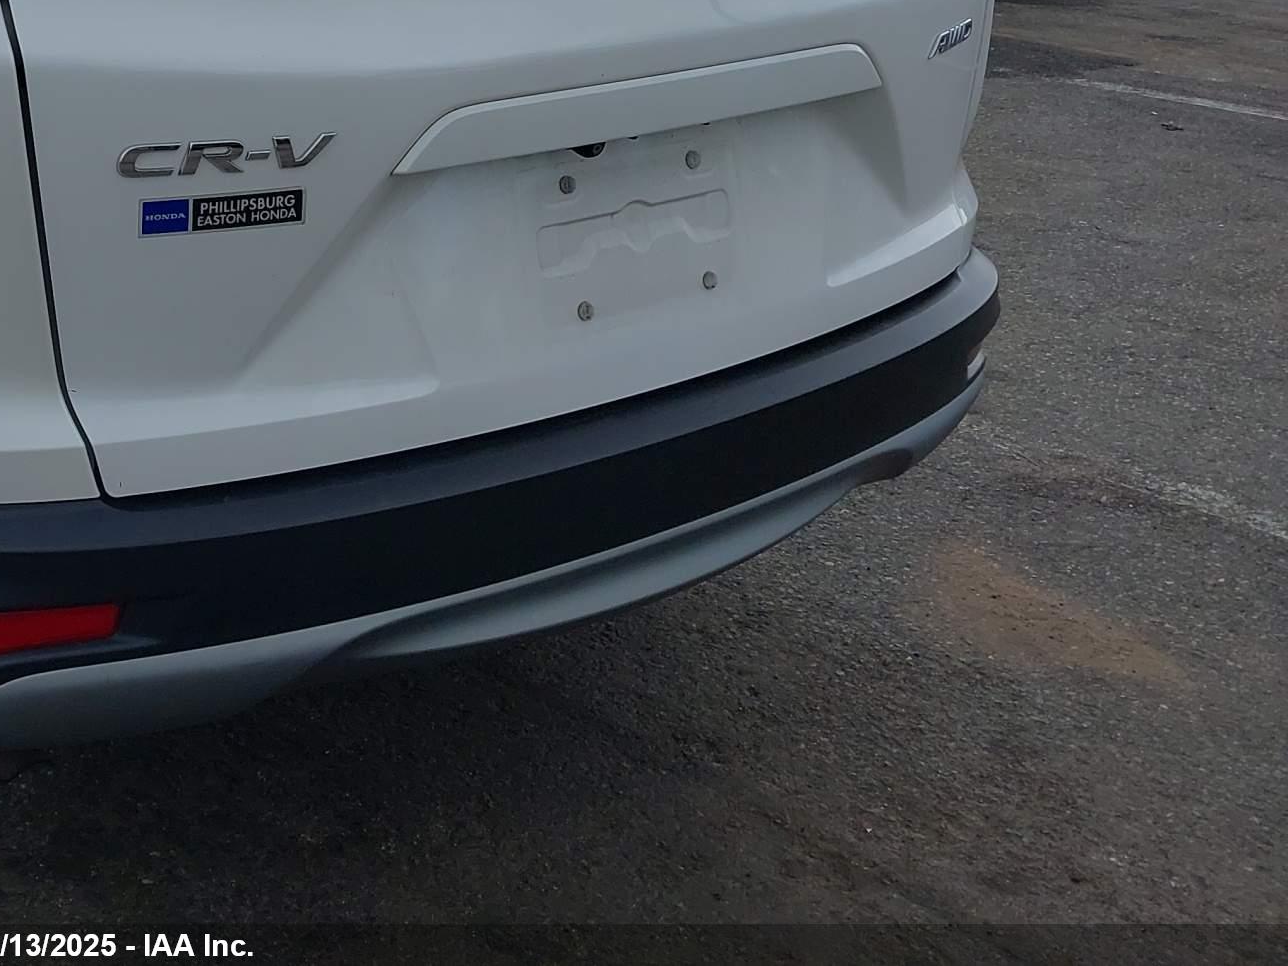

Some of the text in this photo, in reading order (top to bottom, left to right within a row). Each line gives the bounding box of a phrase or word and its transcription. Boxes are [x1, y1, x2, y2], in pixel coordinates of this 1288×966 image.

[927, 18, 972, 60] AWD
[116, 131, 337, 178] CR-V
[199, 194, 296, 215] PHILLIPSBURG
[144, 211, 187, 222] HONDA
[197, 207, 297, 227] EASTON HONDA
